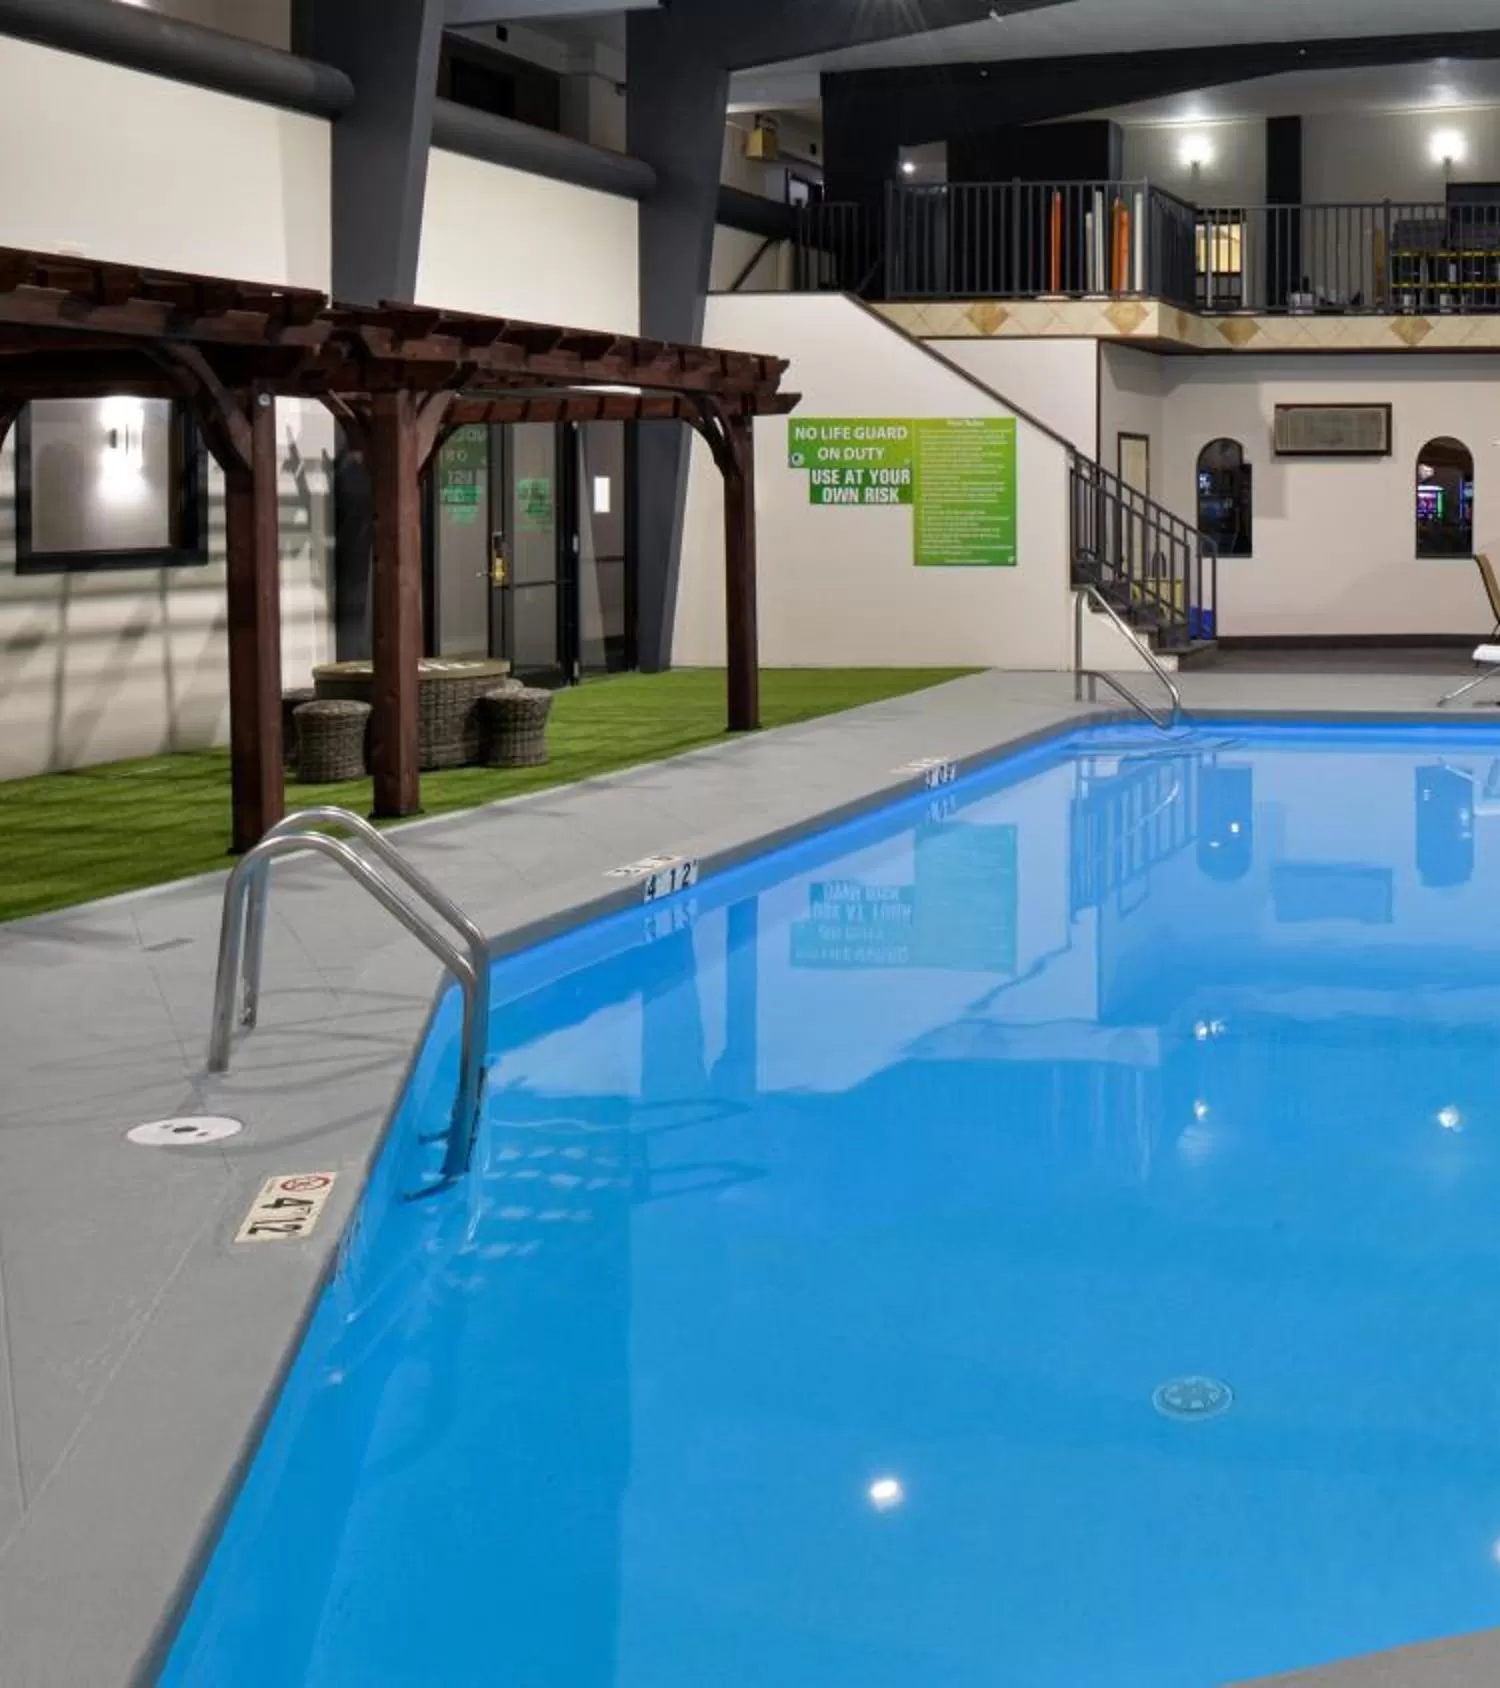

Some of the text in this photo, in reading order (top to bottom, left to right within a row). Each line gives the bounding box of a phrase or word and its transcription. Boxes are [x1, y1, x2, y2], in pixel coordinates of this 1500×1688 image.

[795, 426, 908, 441] NO LIFE GUARD
[817, 447, 885, 461] ON DUTY
[811, 469, 911, 485] USE AT YOUR
[822, 487, 900, 503] OWN RISK
[261, 1197, 315, 1209] 4
[247, 1217, 308, 1235] 12
